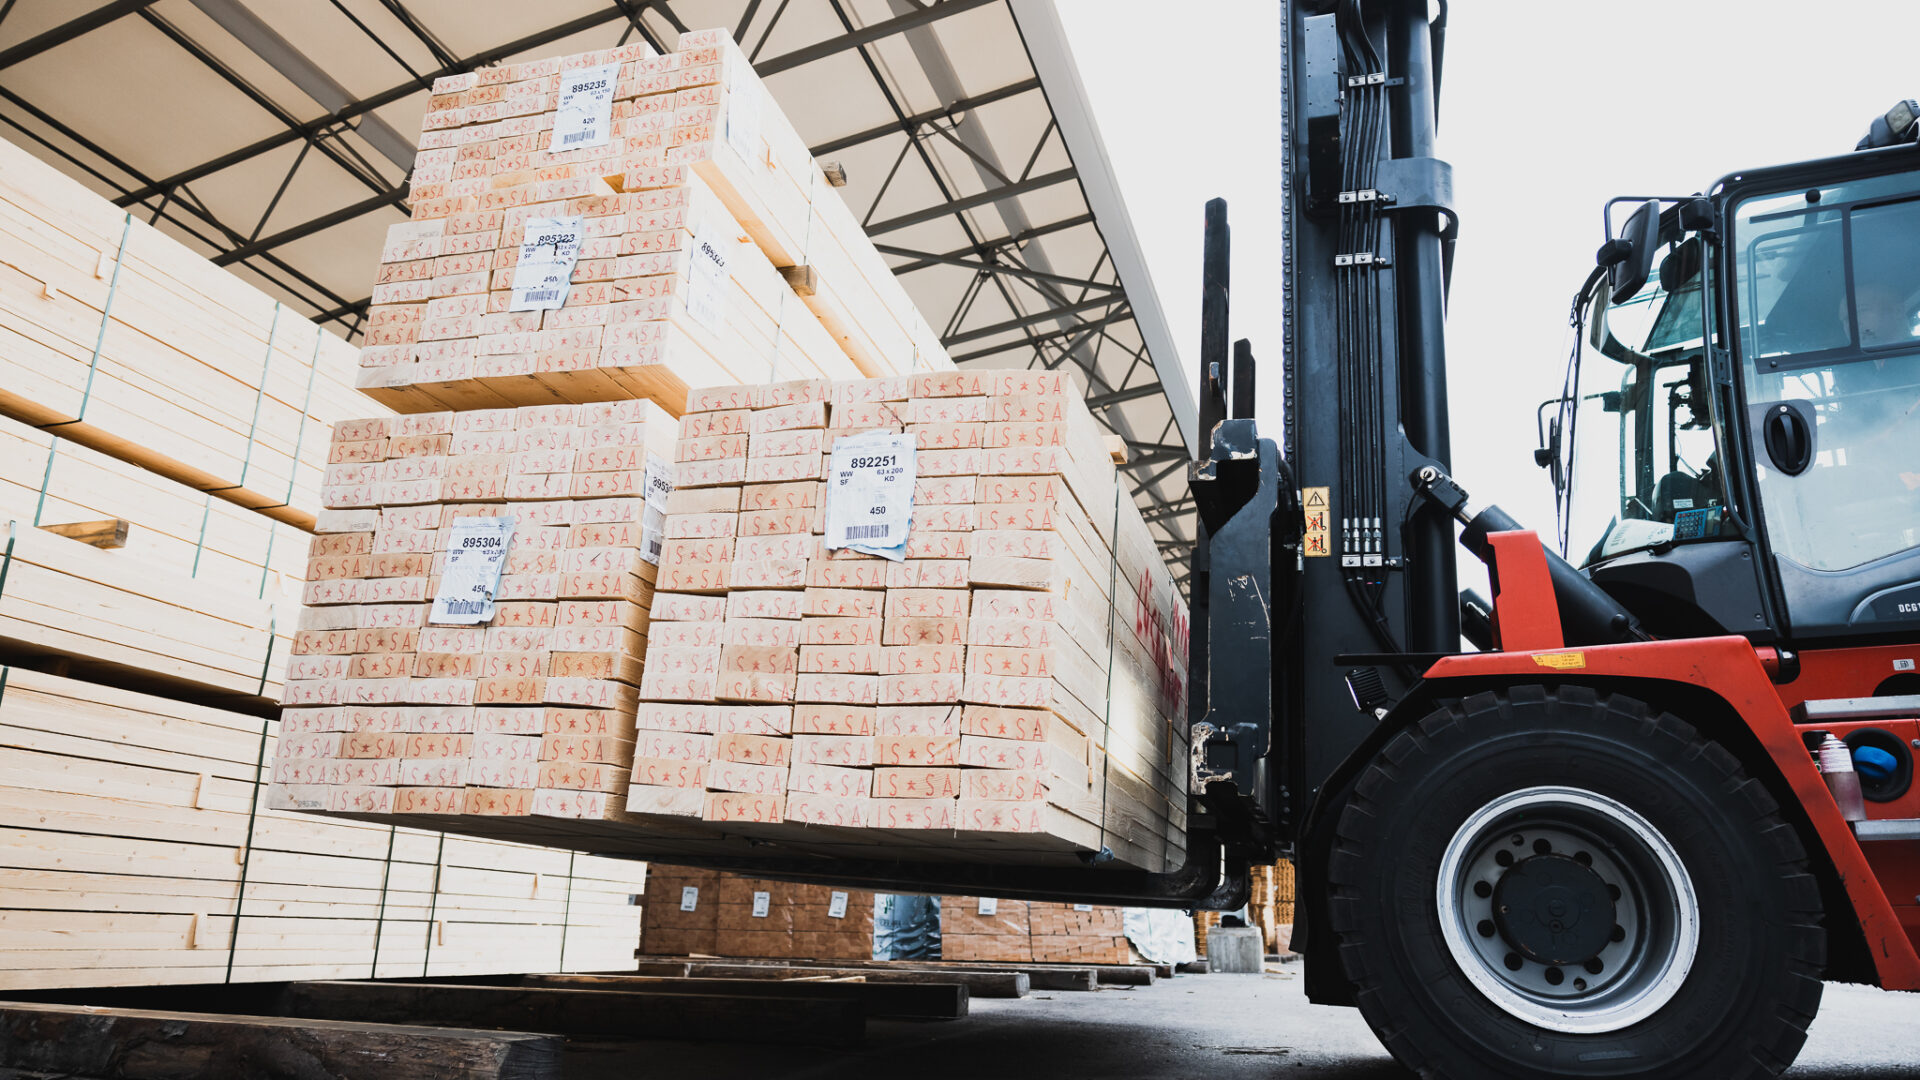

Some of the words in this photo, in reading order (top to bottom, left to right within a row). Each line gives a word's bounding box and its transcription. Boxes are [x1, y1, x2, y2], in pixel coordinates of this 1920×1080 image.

[572, 79, 607, 93] 895235
[851, 454, 896, 469] 892251
[869, 505, 886, 515] 450
[462, 537, 501, 549] 895304
